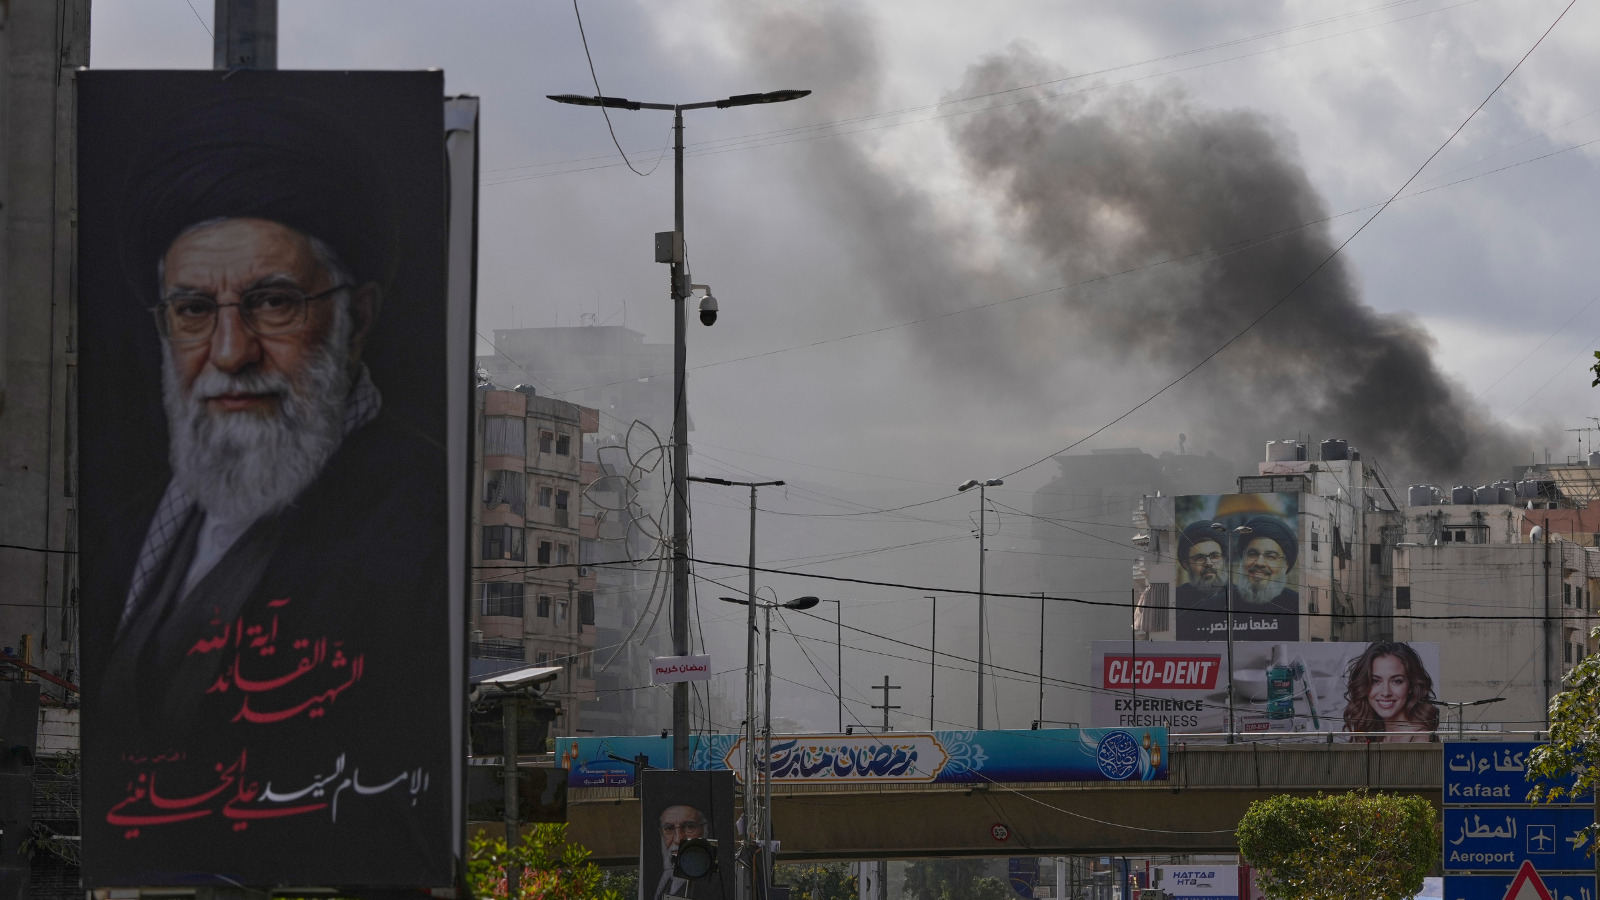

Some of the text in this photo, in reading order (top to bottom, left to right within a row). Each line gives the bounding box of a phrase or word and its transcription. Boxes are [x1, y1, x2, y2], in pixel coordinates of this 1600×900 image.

[205, 637, 327, 694] القائد
[655, 664, 707, 675] رمضان كريم
[1114, 699, 1203, 712] EXPERIENCE
[1119, 714, 1198, 727] FRESHNESS
[834, 744, 918, 777] رمضان
[1449, 749, 1525, 775] كفاءات
[1448, 783, 1511, 797] Kafaat
[1449, 814, 1517, 845] المطار
[1450, 850, 1515, 865] Aeroport
[1173, 871, 1215, 879] HATTAB
